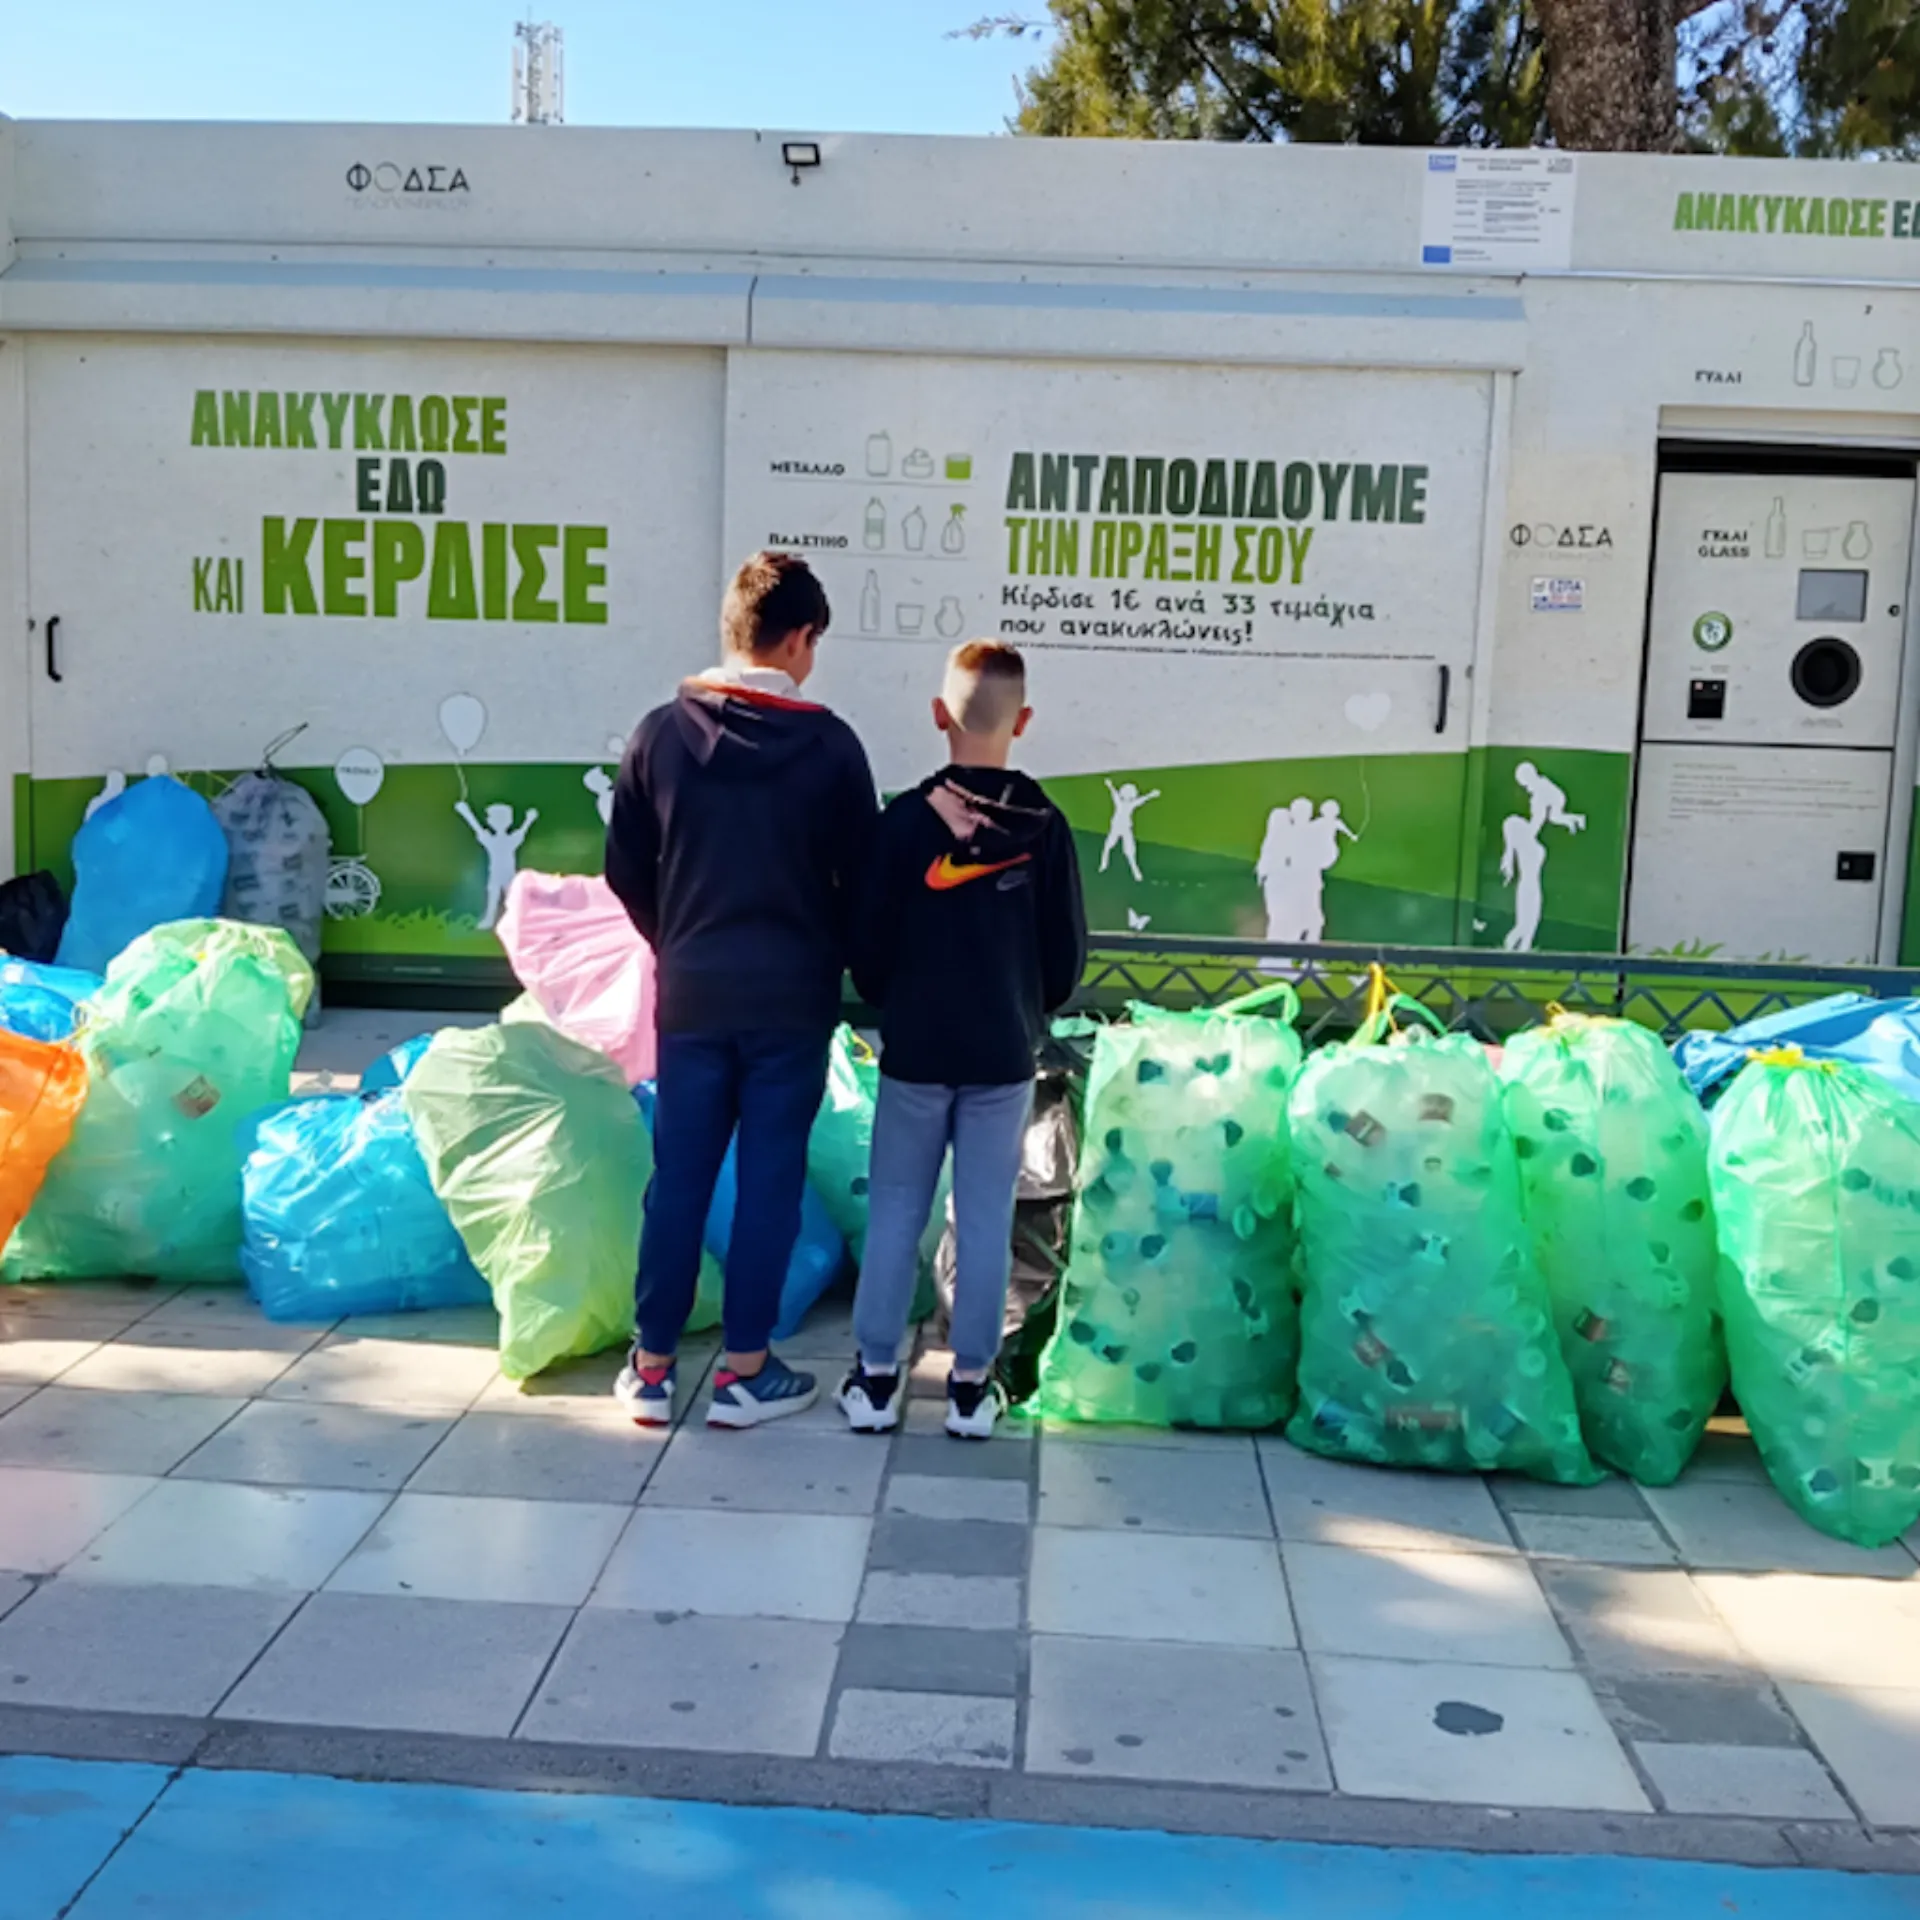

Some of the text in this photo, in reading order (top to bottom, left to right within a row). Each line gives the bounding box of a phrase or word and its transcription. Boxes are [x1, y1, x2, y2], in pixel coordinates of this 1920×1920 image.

[1673, 192, 1887, 237] ΑΝΑΚΥΚΛΩΣΕ
[1694, 369, 1742, 384] ΓΥΑΛΙ
[190, 389, 507, 455] ΑΝΑΚΥΚΛΩΣΕ
[356, 457, 447, 514] ΕΔΩ
[1005, 451, 1429, 524] ΑΝΤΑΠΟΔΙΔΟΥΜΕ
[192, 515, 608, 624] ΚΑΙ ΚΕΡΔΙΣΕ
[1005, 517, 1313, 585] ΤΗΝ ΠΡΑΞΗ ΣΟΥ
[1698, 544, 1750, 558] GLASS
[1000, 619, 1045, 635] που
[1111, 588, 1140, 611] 1€
[1155, 591, 1206, 613] ανά
[1222, 593, 1256, 615] 33
